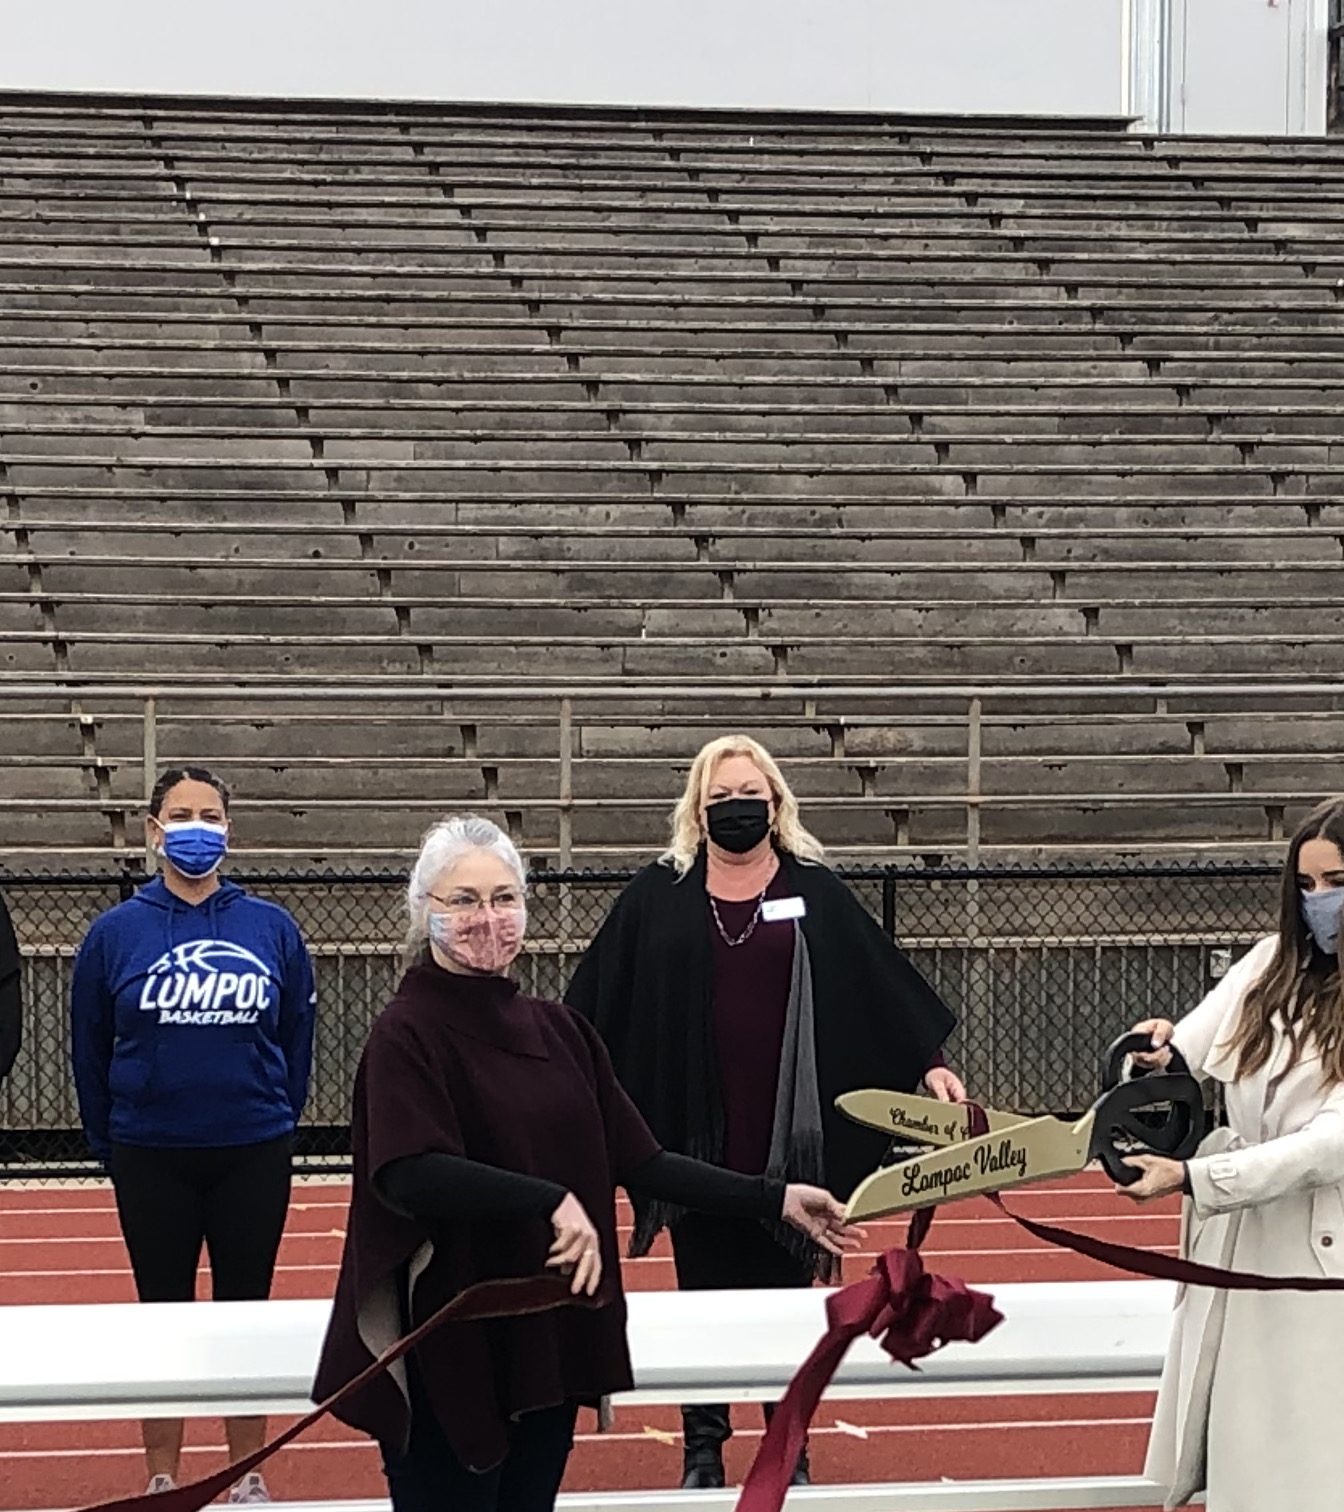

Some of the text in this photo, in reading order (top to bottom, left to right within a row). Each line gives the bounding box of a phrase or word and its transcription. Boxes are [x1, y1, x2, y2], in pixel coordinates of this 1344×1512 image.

[138, 973, 271, 1010] LOMPOC
[157, 1010, 259, 1025] BASKETBALL
[889, 1106, 939, 1135] Chamber
[943, 1120, 957, 1141] of
[902, 1139, 1027, 1196] Lompoc Valley
